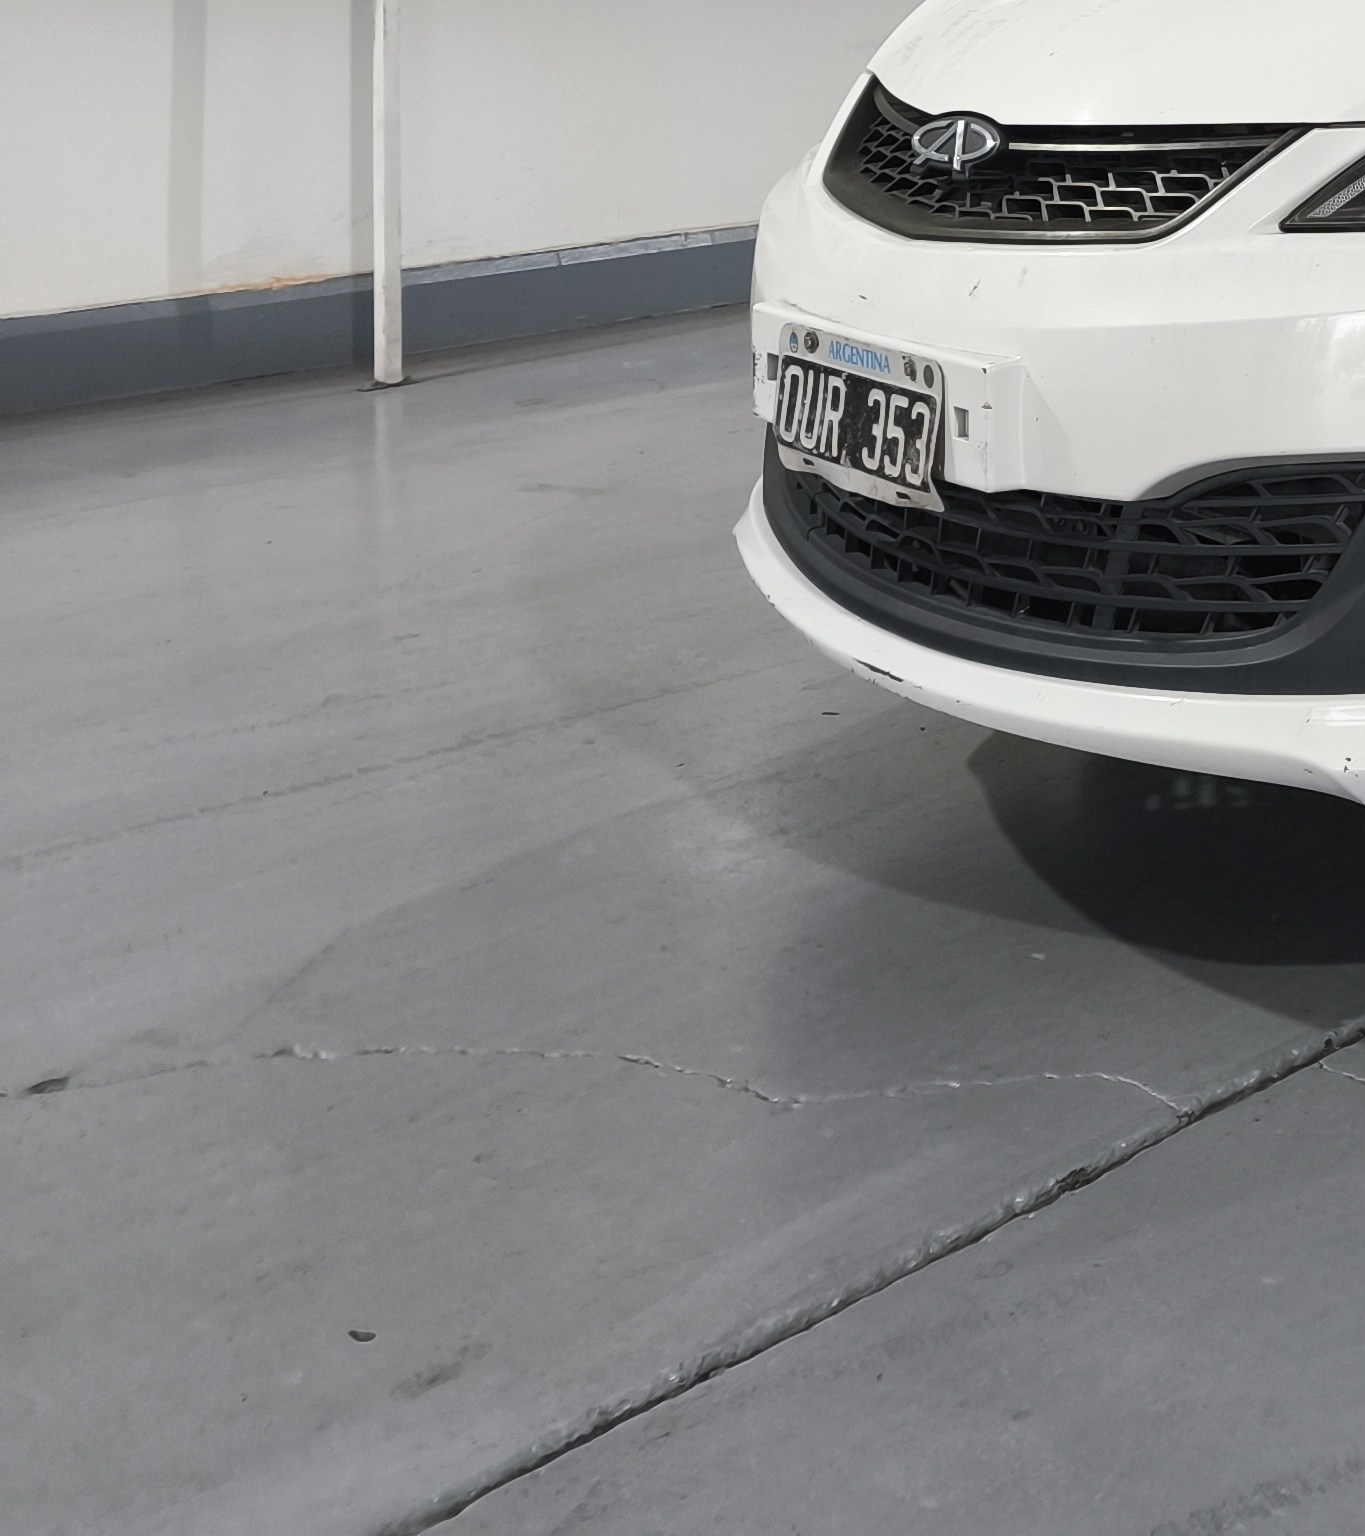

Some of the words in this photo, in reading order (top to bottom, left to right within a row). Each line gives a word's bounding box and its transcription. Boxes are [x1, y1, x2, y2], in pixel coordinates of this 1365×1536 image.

[828, 340, 891, 374] ARGENTINA
[779, 364, 847, 458] OUR
[861, 388, 931, 487] 353
